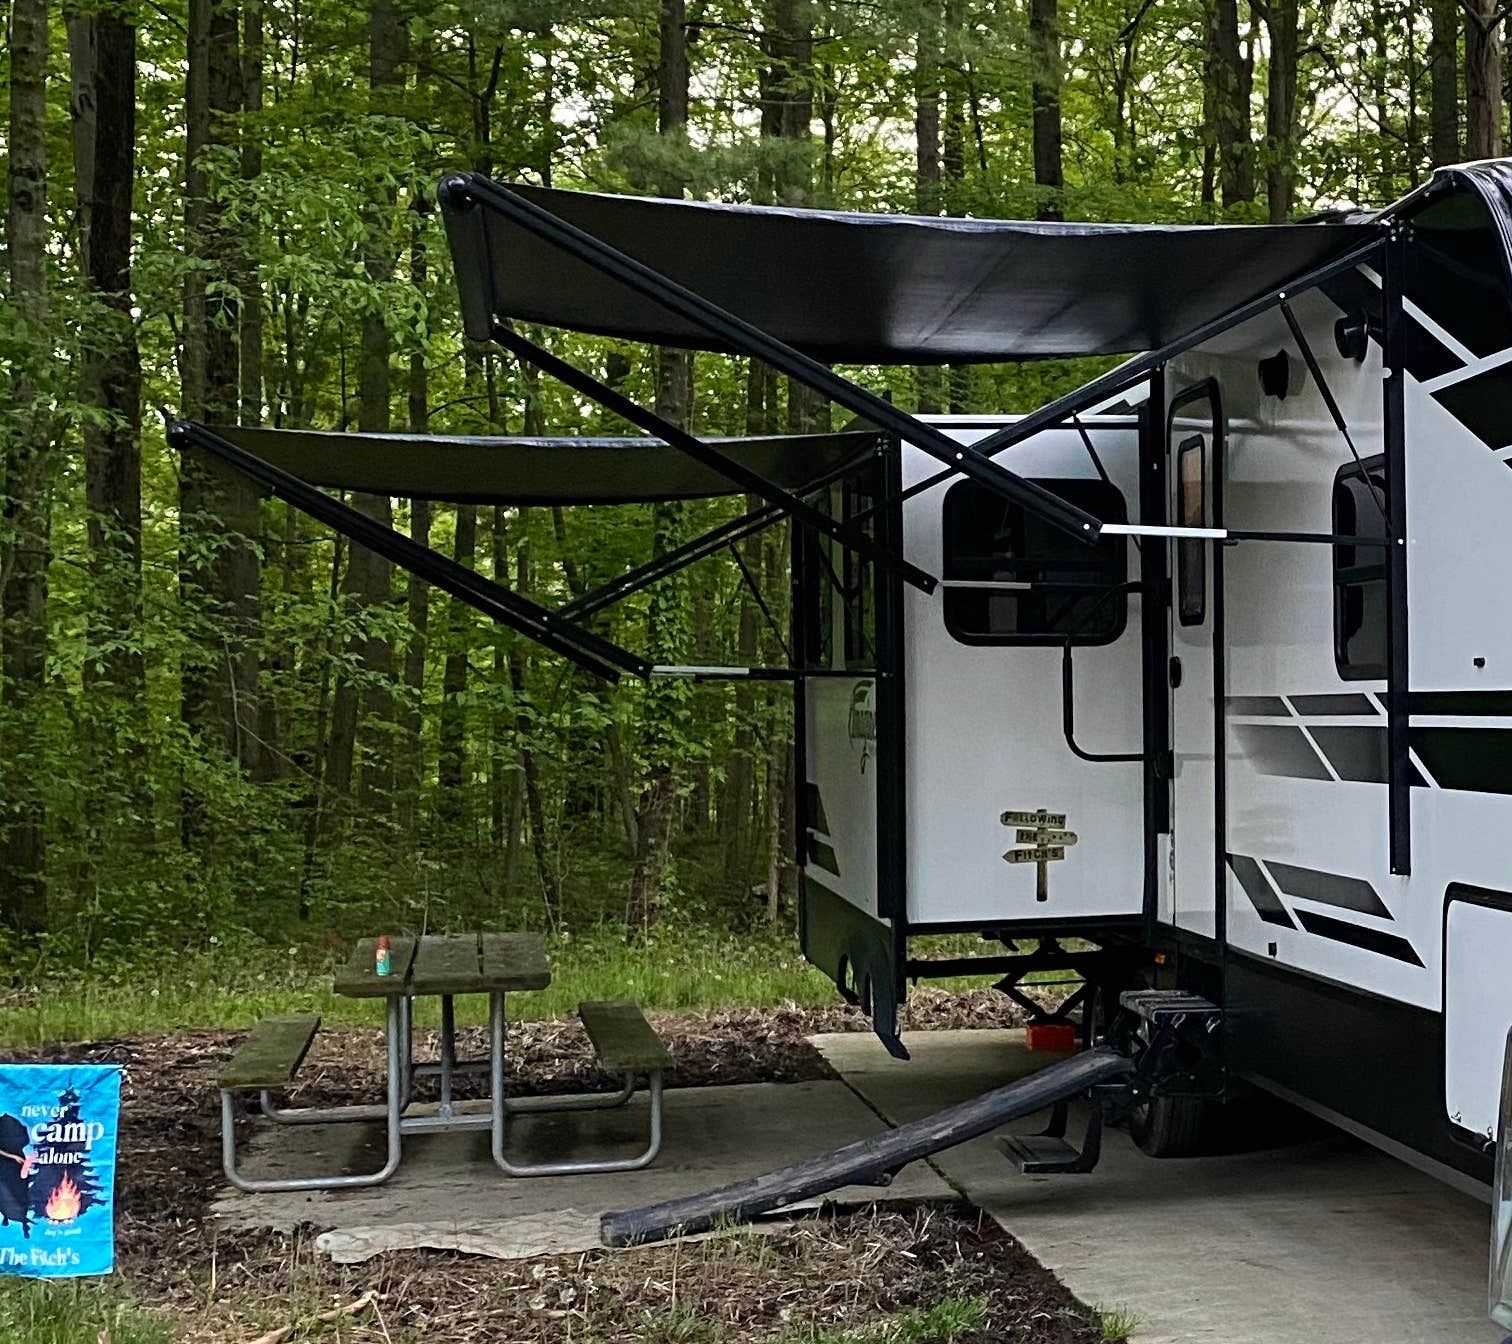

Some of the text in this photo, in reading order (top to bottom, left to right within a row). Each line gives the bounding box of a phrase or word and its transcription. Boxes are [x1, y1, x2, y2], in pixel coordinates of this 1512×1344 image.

[21, 1104, 68, 1119] never
[31, 1121, 104, 1150] camp
[38, 1147, 82, 1165] alone
